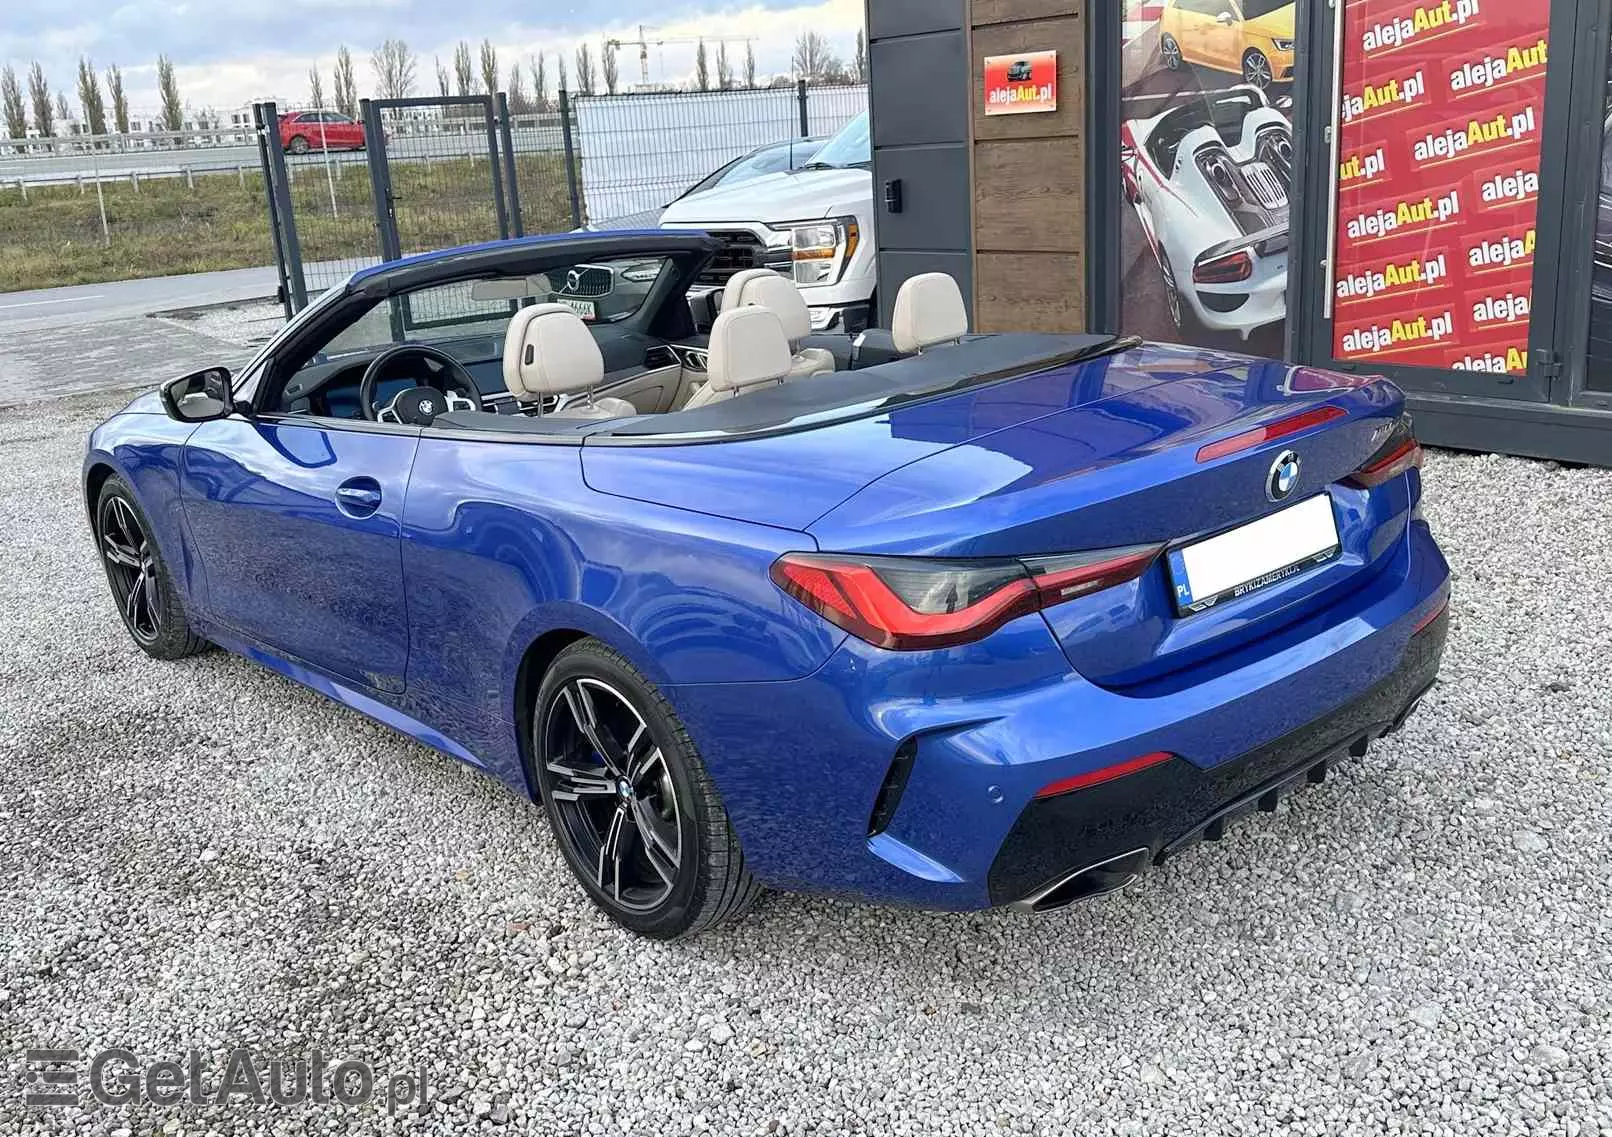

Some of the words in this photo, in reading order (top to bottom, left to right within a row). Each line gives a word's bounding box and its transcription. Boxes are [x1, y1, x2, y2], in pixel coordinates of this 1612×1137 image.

[1362, 0, 1480, 51] alejaAut.pl
[1450, 40, 1548, 91] alejaAut
[989, 83, 1053, 105] alejaAut.pl
[1341, 71, 1425, 122] jaAut.pl
[1414, 107, 1536, 161] alejaAut.pl
[1481, 170, 1539, 201] aleja
[1347, 191, 1460, 238] alejaAut.pl
[1336, 255, 1447, 298] alejaAut.pl
[1472, 287, 1532, 322] aleja
[1342, 312, 1453, 352] alejaAut.pl
[1176, 583, 1190, 598] PL
